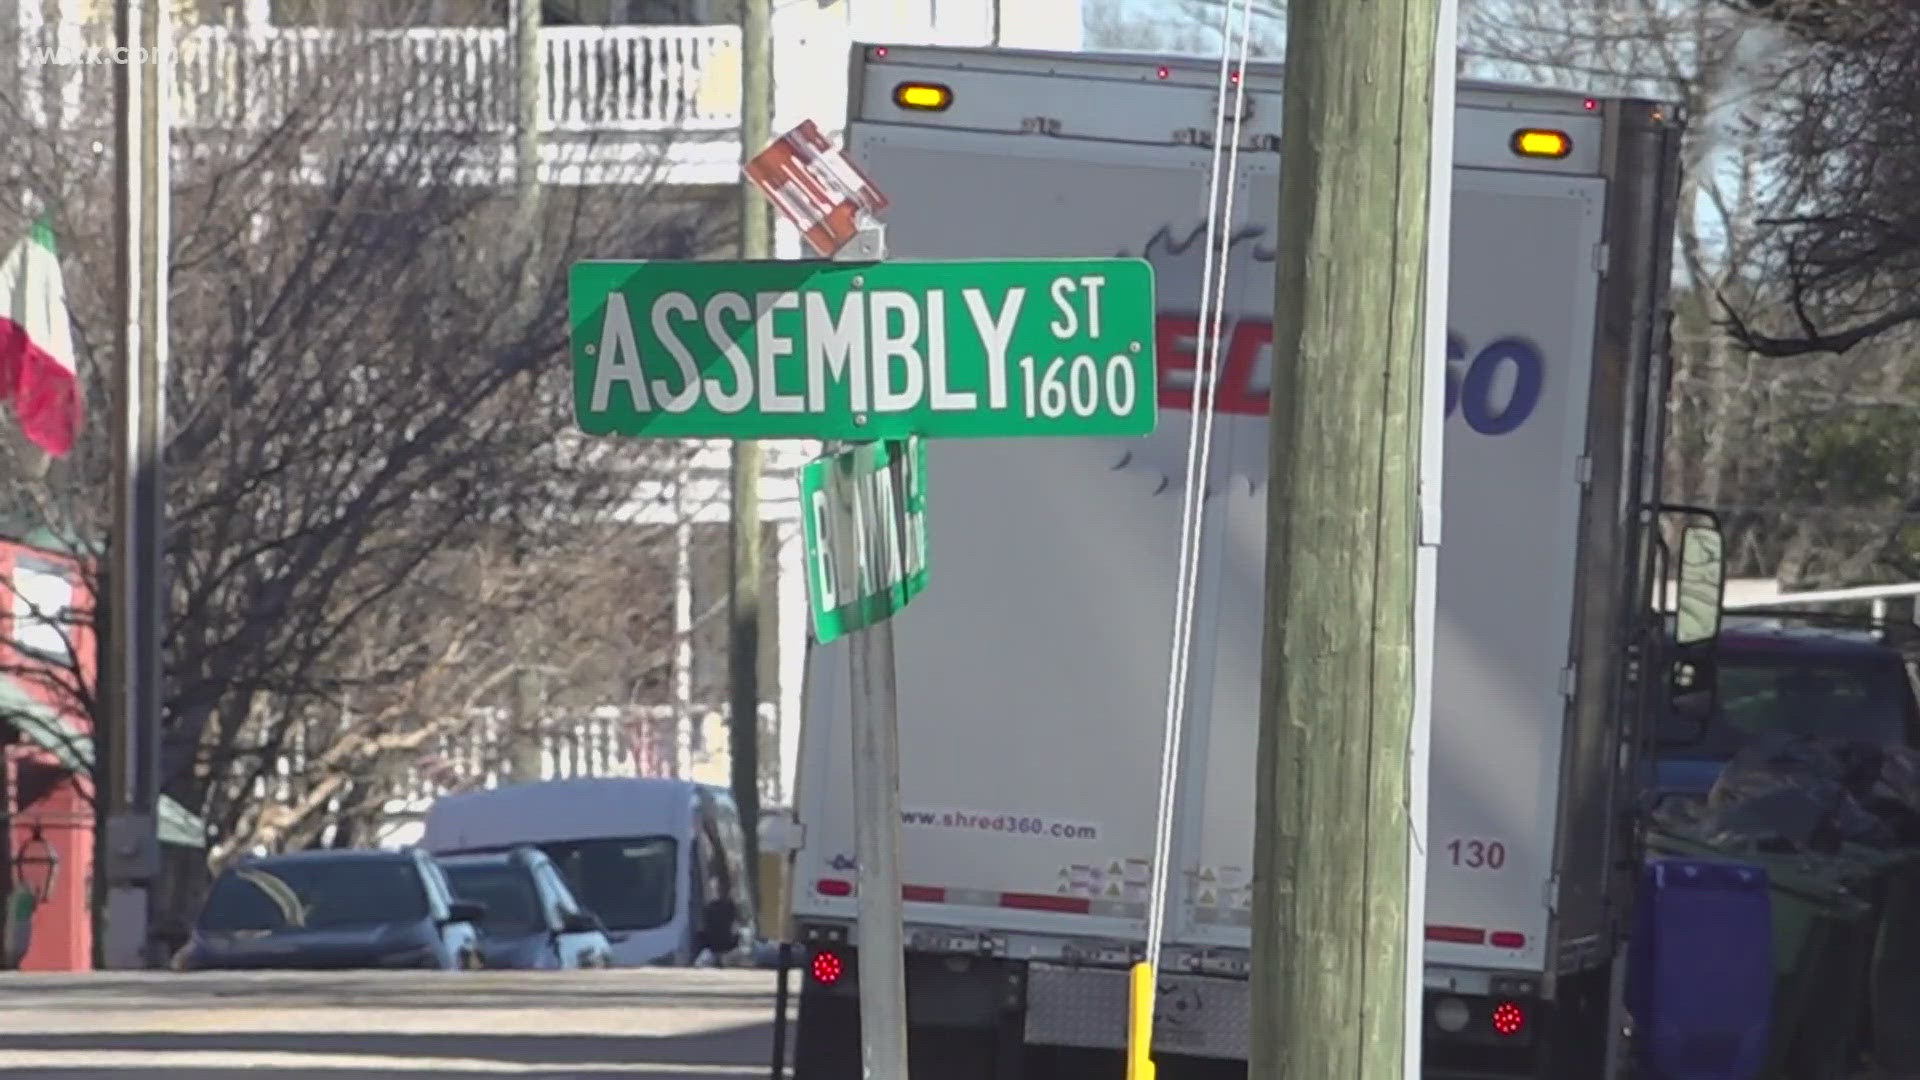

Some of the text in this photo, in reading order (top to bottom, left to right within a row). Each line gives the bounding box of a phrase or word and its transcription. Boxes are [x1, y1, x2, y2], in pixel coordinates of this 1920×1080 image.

[590, 276, 1106, 414] ASSEMBLY ST
[1019, 353, 1136, 419] 1600
[900, 811, 1098, 840] ww.shred360.com
[1447, 839, 1506, 870] 130
